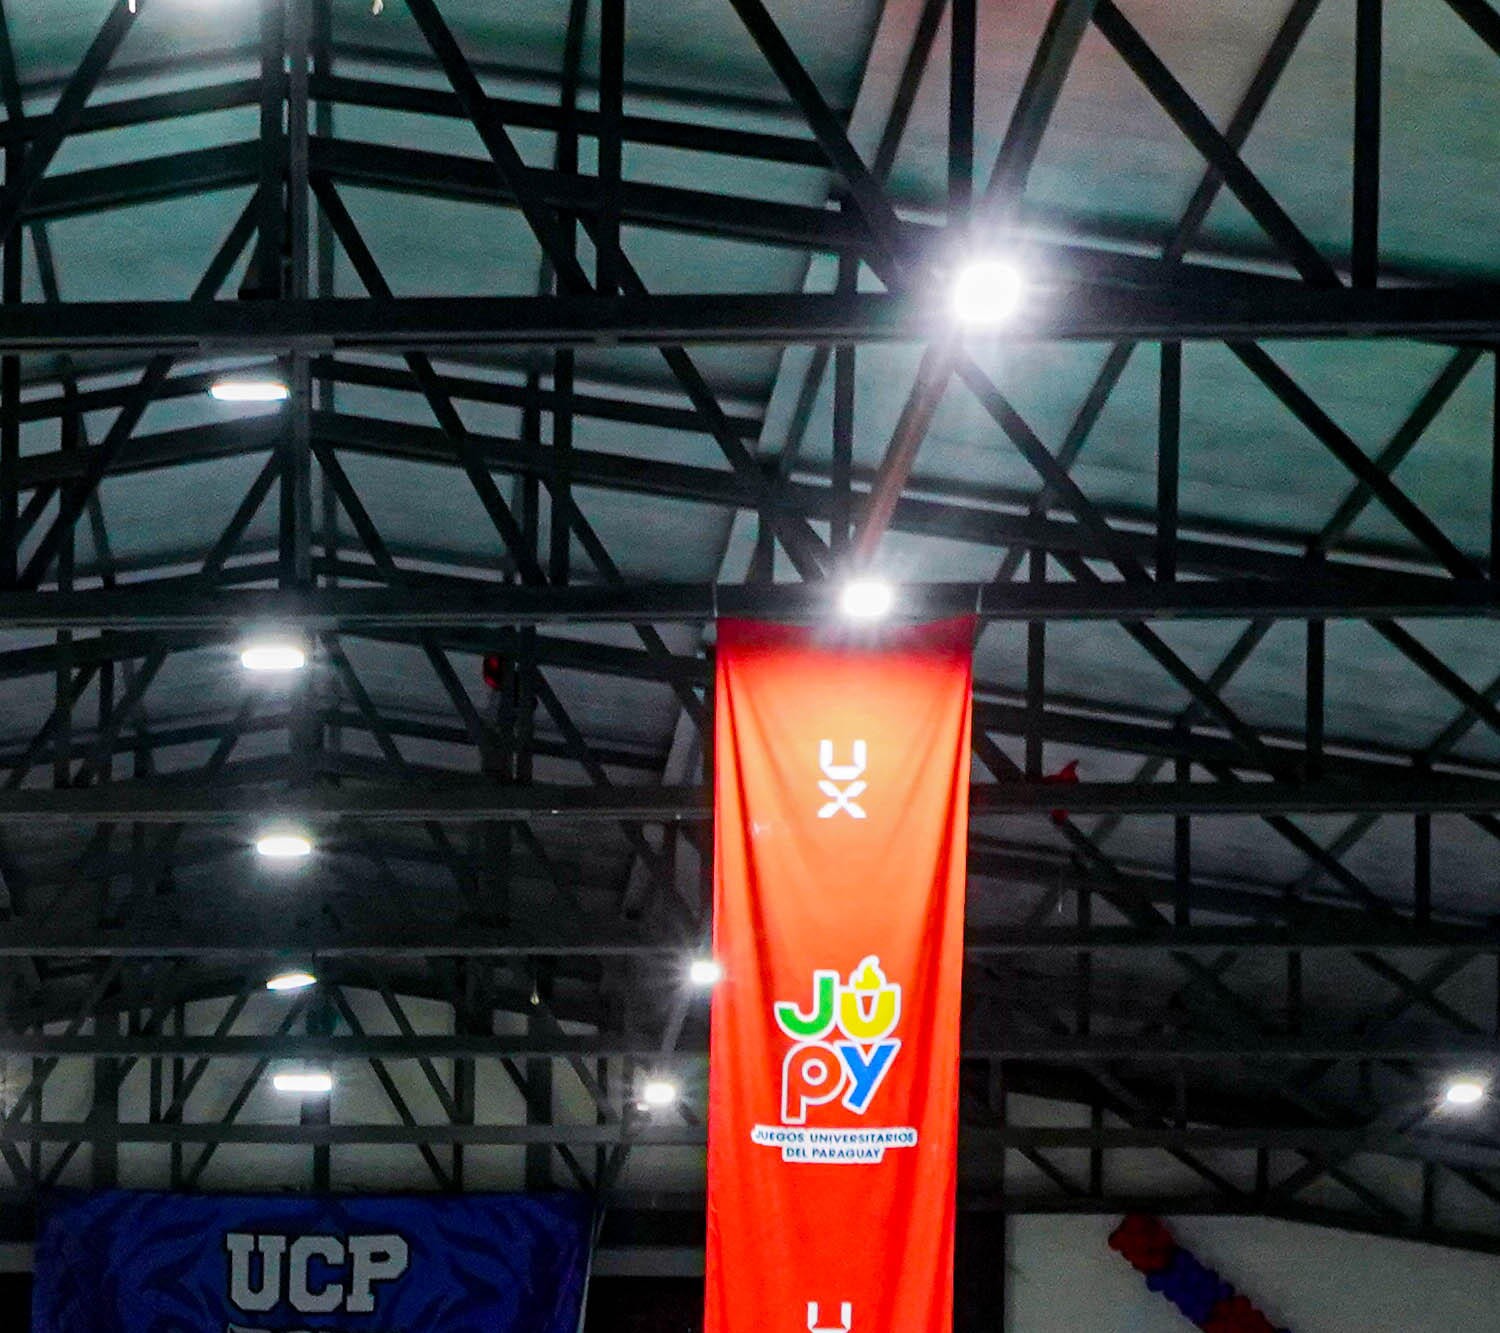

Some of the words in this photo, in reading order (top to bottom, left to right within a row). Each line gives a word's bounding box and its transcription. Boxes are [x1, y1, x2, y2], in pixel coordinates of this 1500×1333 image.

[755, 1130, 805, 1146] JUEGOS
[786, 1147, 807, 1159] DEL
[810, 1147, 882, 1159] PARAGUAY
[226, 1233, 408, 1314] UCP
